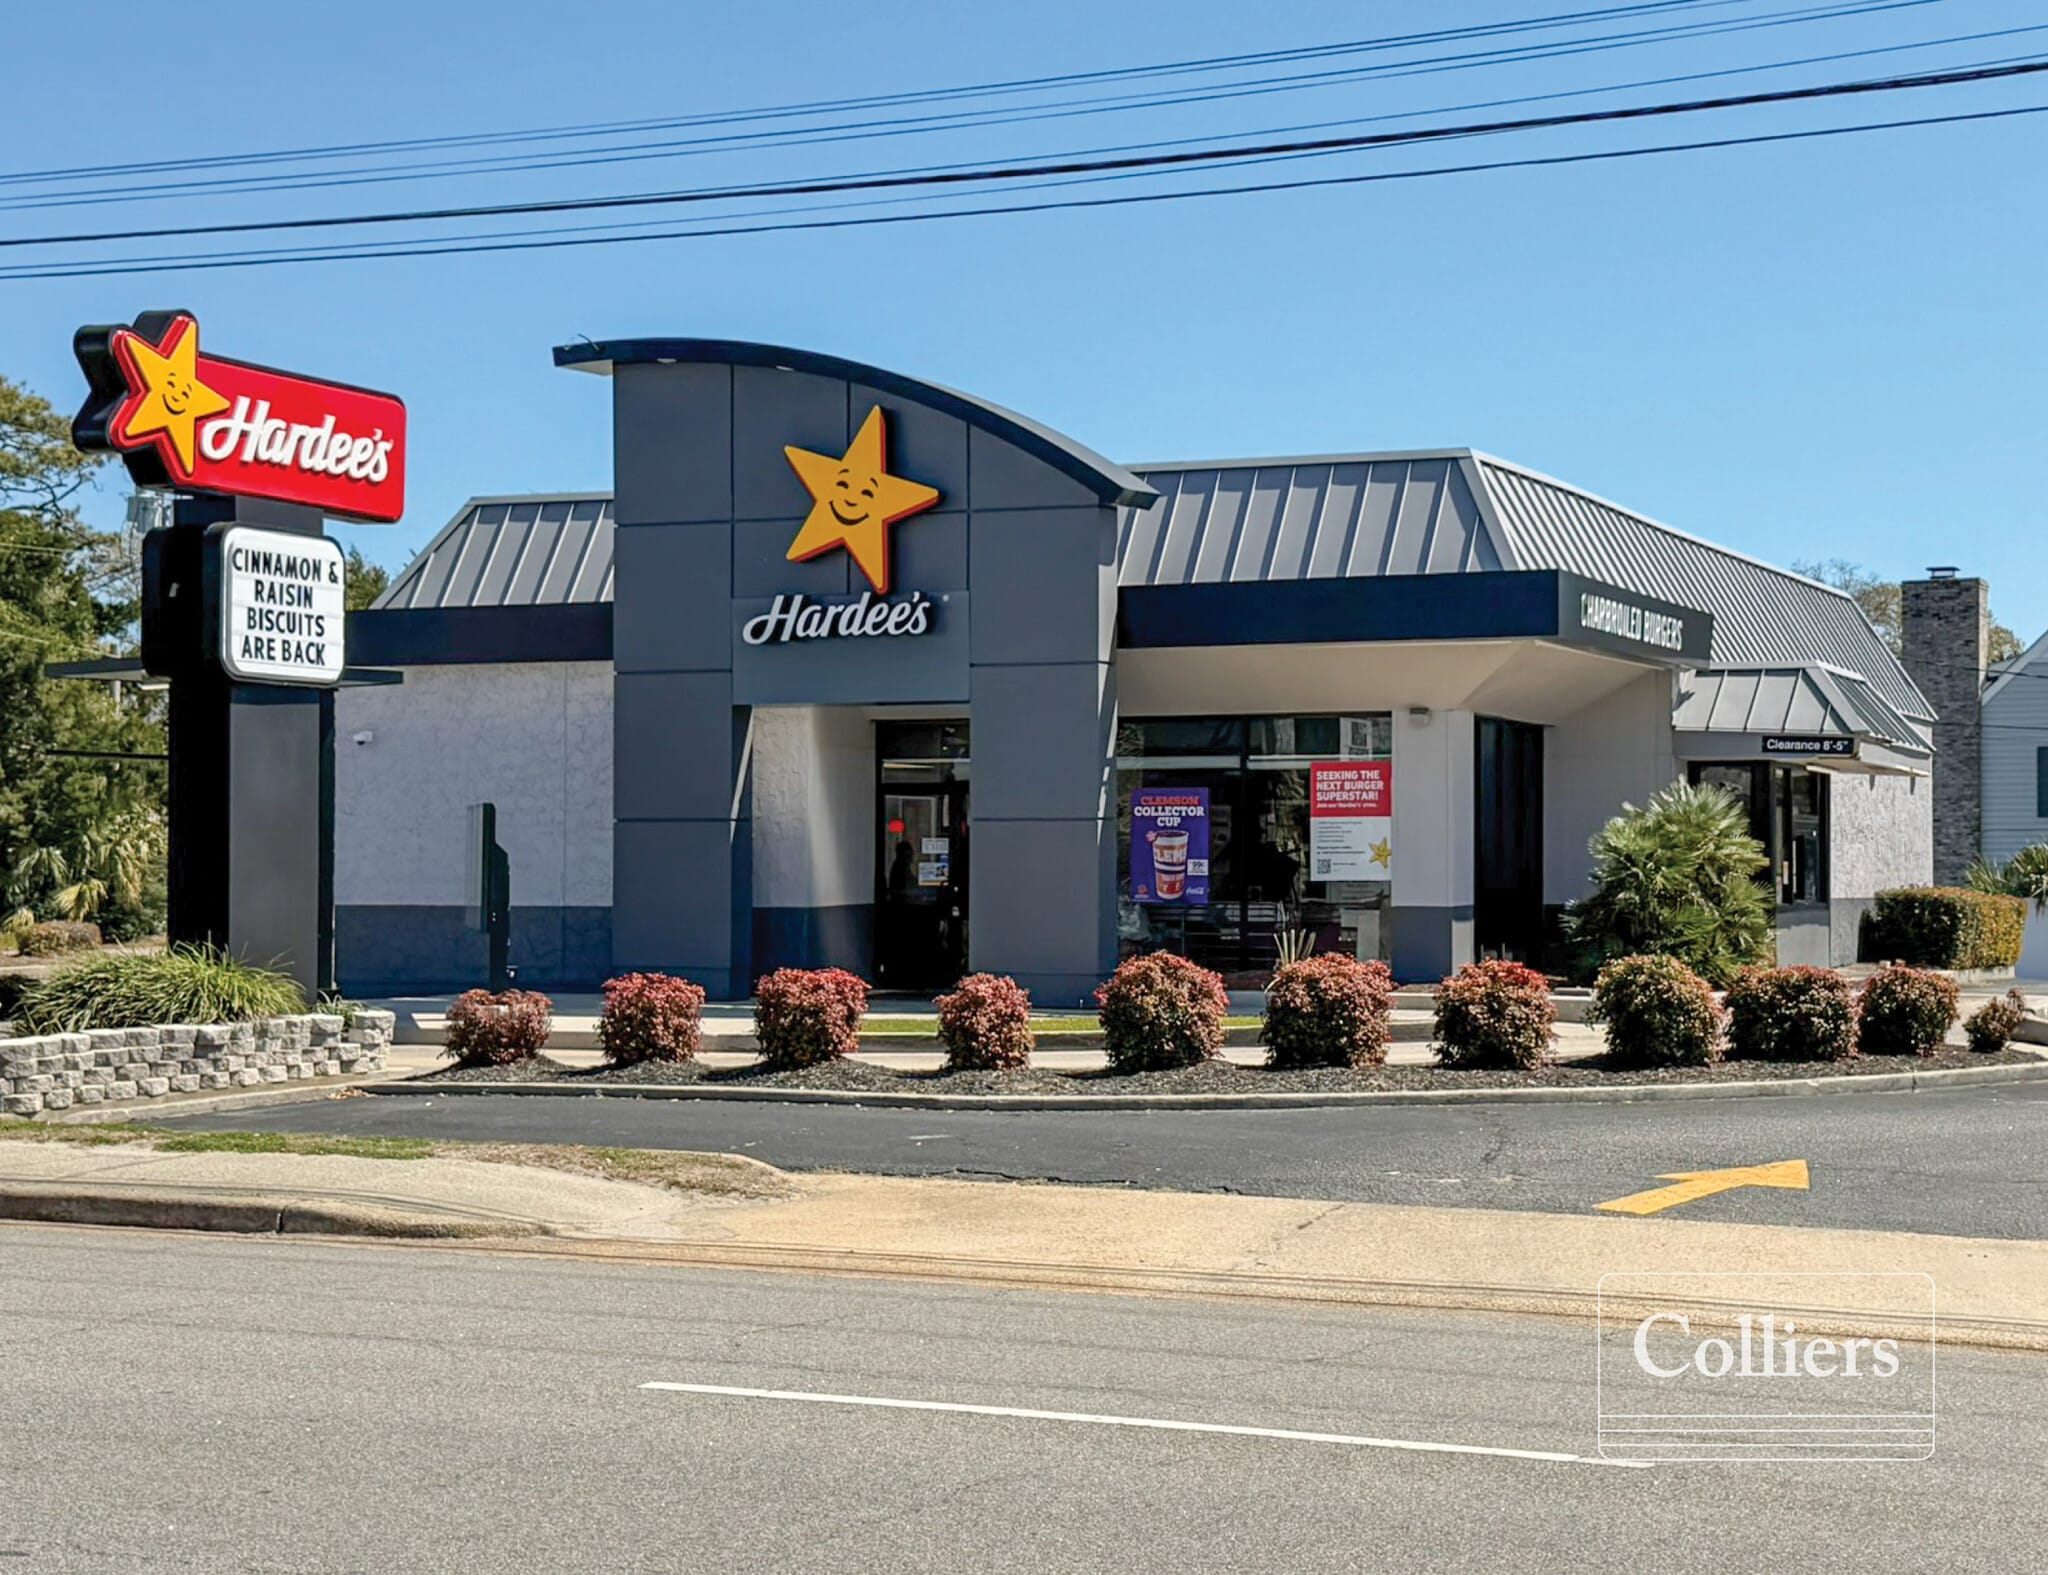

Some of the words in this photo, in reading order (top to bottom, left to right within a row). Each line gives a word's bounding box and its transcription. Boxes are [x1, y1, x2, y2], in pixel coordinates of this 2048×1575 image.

[201, 395, 394, 482] Hardee's
[232, 548, 321, 582] CINNAMON
[328, 561, 339, 583] &
[254, 579, 313, 608] RAISIN
[247, 606, 325, 637] BISCUITS
[743, 591, 930, 645] Hardee's
[1643, 610, 1683, 651] BURGERS
[241, 635, 276, 660] ARE
[281, 639, 325, 666] BACK
[1767, 738, 1820, 751] Clearance
[1316, 770, 1358, 780] SEEKING
[1360, 770, 1380, 780] THE
[1316, 781, 1342, 790] NEXT
[1344, 780, 1384, 790] BURGER
[1316, 791, 1379, 801] SUPERSTAR!
[1133, 806, 1205, 817] COLLECTOR
[1156, 817, 1181, 827] CUP
